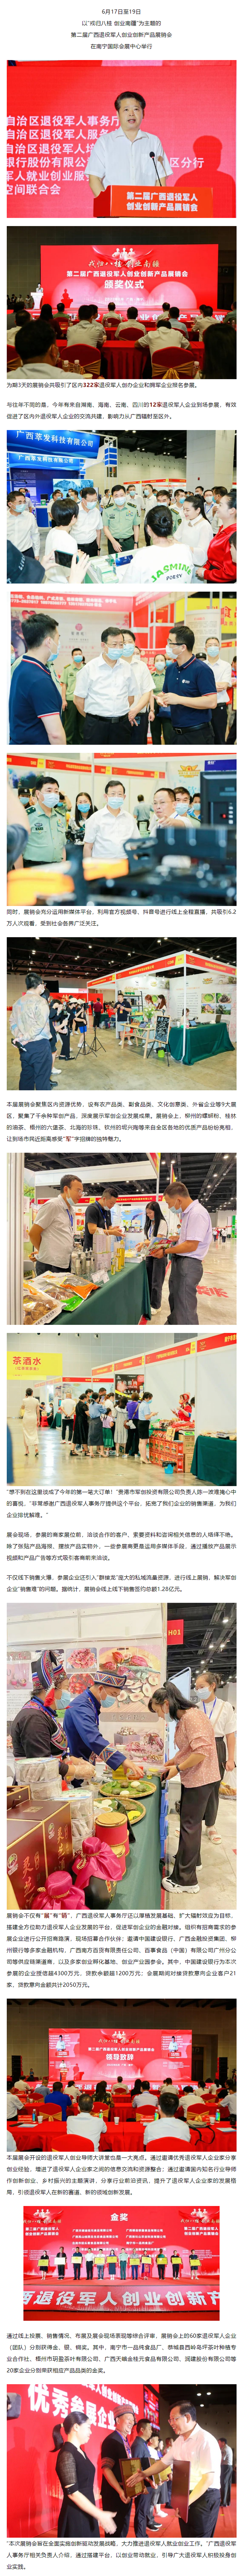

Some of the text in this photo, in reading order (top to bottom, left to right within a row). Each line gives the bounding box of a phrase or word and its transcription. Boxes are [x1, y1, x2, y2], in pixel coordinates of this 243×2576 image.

[7, 157, 204, 168] 银行股份有限公 区分行
[127, 192, 198, 201] 第二届广西退役军人
[127, 202, 198, 212] 创业创新产品展销会
[104, 280, 144, 289] 颁奖仪式
[16, 430, 93, 448] 广西萃发科技有限公司
[19, 455, 73, 464] 广西萃发科技有限公司
[151, 563, 192, 582] JASMINE
[13, 1356, 41, 1365] 茶酒水
[111, 2213, 128, 2221] 金奖
